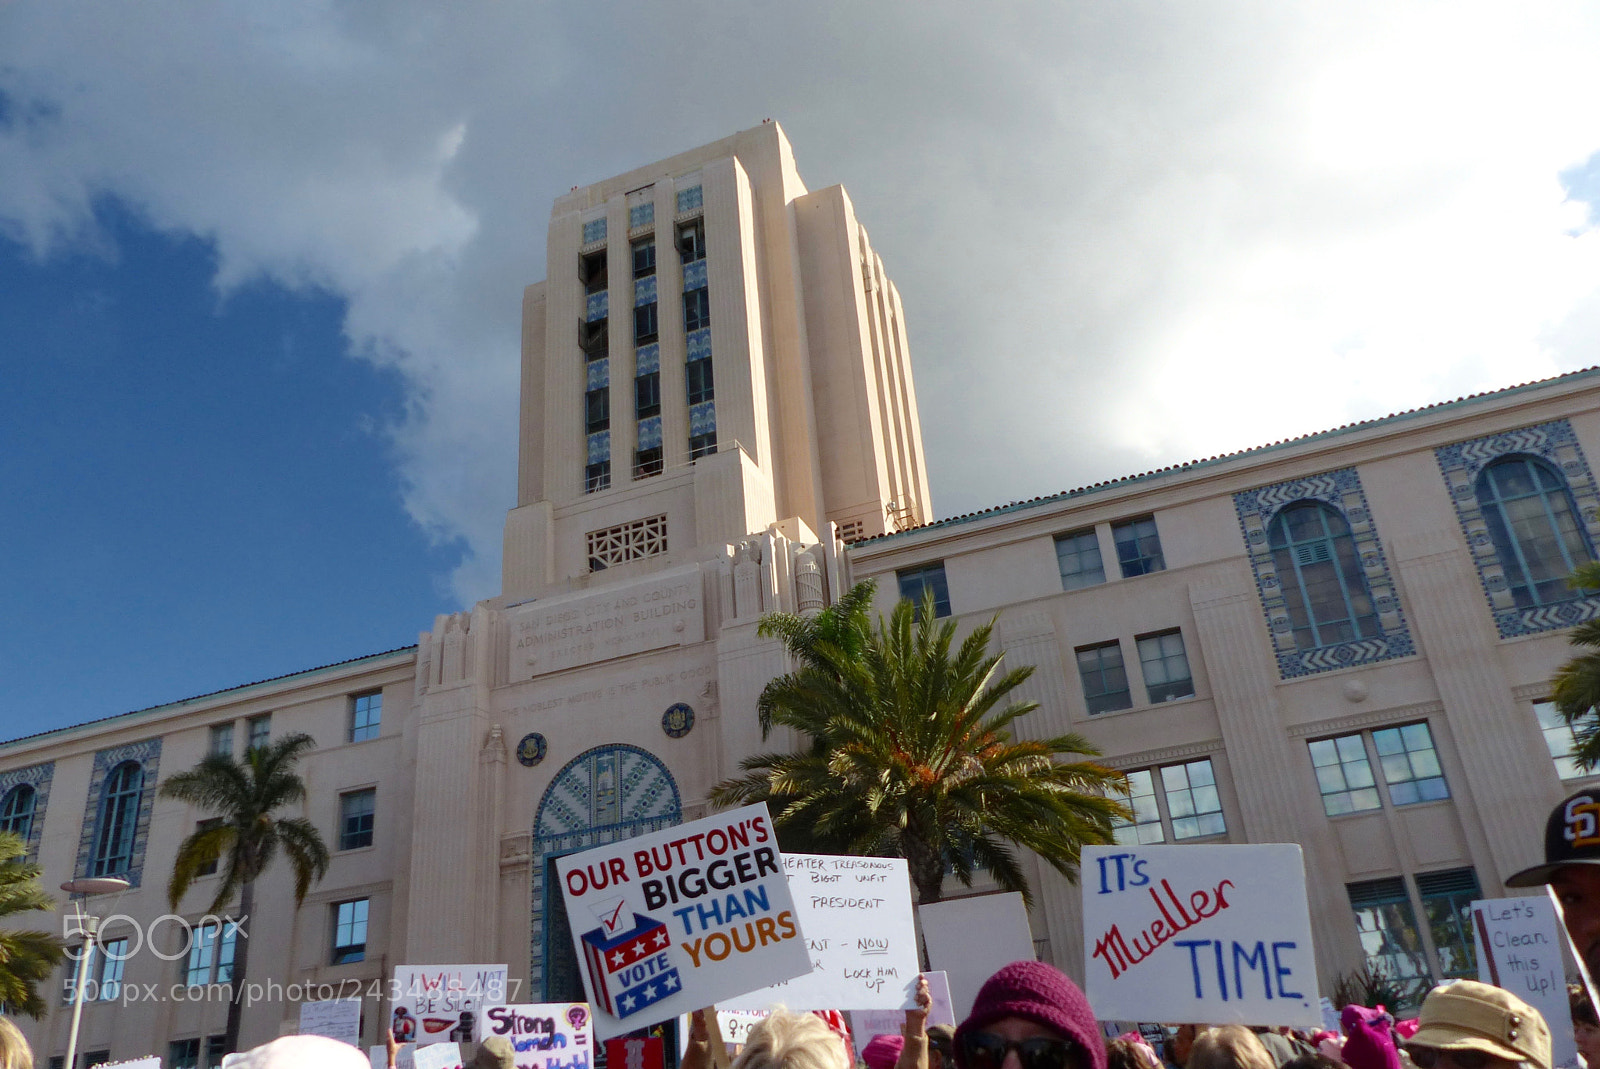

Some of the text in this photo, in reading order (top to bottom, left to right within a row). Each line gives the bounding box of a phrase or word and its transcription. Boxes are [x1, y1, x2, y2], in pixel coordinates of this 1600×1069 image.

[613, 596, 638, 610] AND
[644, 585, 692, 604] COUNTY
[516, 617, 624, 650] ADMINISTRATION
[633, 599, 697, 624] BUILDING
[566, 816, 769, 896] OUR BUTTON'S
[782, 857, 895, 872] HEATER TREASONOUS
[642, 847, 779, 911] BIGGER
[809, 871, 843, 884] BIGOT
[855, 873, 888, 884] UNFIT
[673, 884, 771, 935] THAN
[810, 895, 886, 910] PRESIDENT
[1487, 900, 1534, 921] Let's
[681, 910, 797, 968] YOURS
[1092, 878, 1236, 980] Mueller
[1493, 930, 1549, 948] Clean
[857, 937, 889, 951] NOW
[618, 952, 671, 988] VOTE
[843, 966, 899, 979] LOCK HIM
[1506, 954, 1540, 973] this
[421, 971, 467, 992] WILL
[475, 970, 506, 994] NOT
[865, 977, 885, 994] UP
[415, 996, 437, 1016] BE
[487, 1007, 555, 1050] Strong
